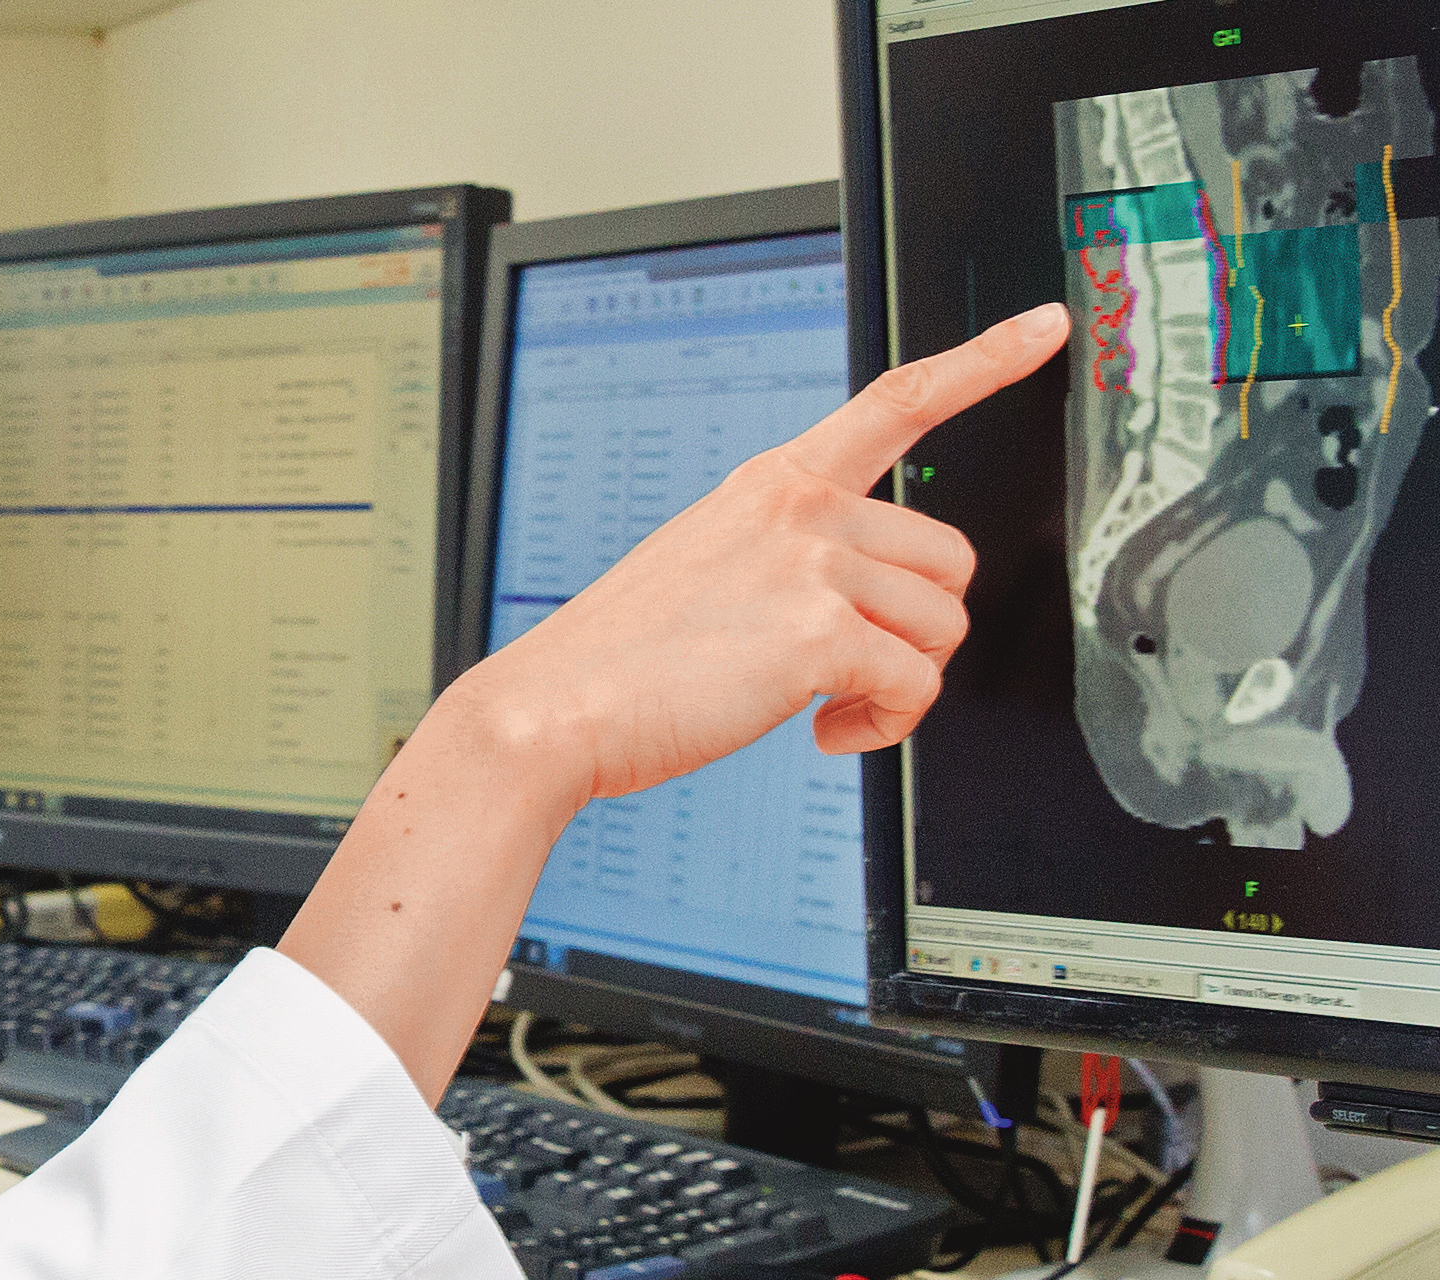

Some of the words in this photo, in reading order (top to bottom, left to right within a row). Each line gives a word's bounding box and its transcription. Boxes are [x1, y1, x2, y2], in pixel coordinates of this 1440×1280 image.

[1212, 27, 1243, 48] GH
[922, 466, 936, 483] P
[1245, 881, 1260, 897] F
[1332, 1108, 1367, 1123] SELECT
